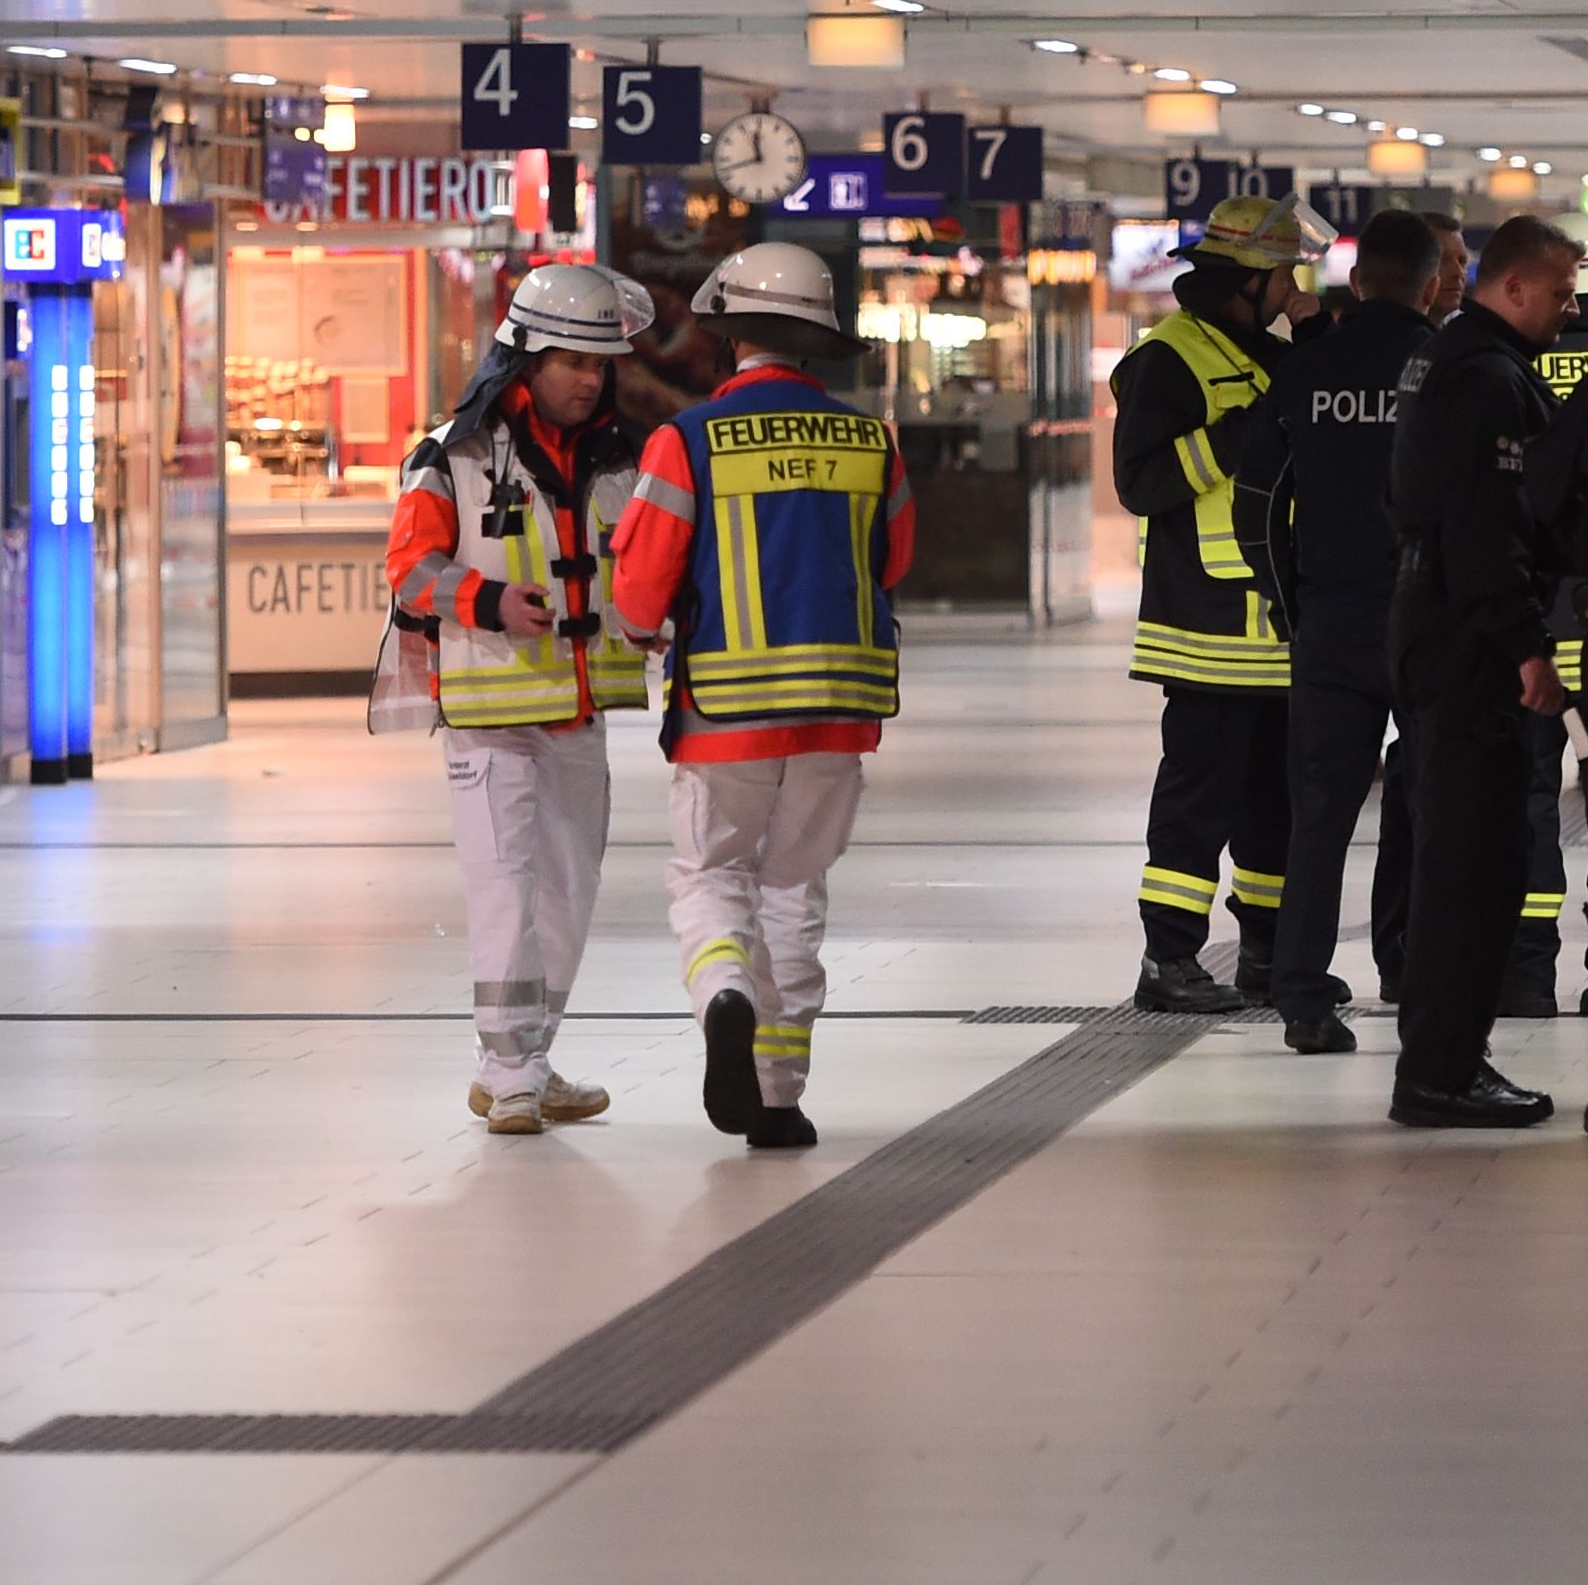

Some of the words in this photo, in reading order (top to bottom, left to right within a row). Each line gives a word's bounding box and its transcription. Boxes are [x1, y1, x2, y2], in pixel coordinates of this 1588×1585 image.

[472, 49, 518, 116] 4
[615, 71, 655, 135] 5
[891, 116, 928, 171] 6
[976, 130, 1007, 180] 7
[1170, 163, 1201, 206] 9
[713, 416, 881, 448] FEUERWEHR
[768, 458, 816, 480] NEF
[826, 460, 837, 480] 7
